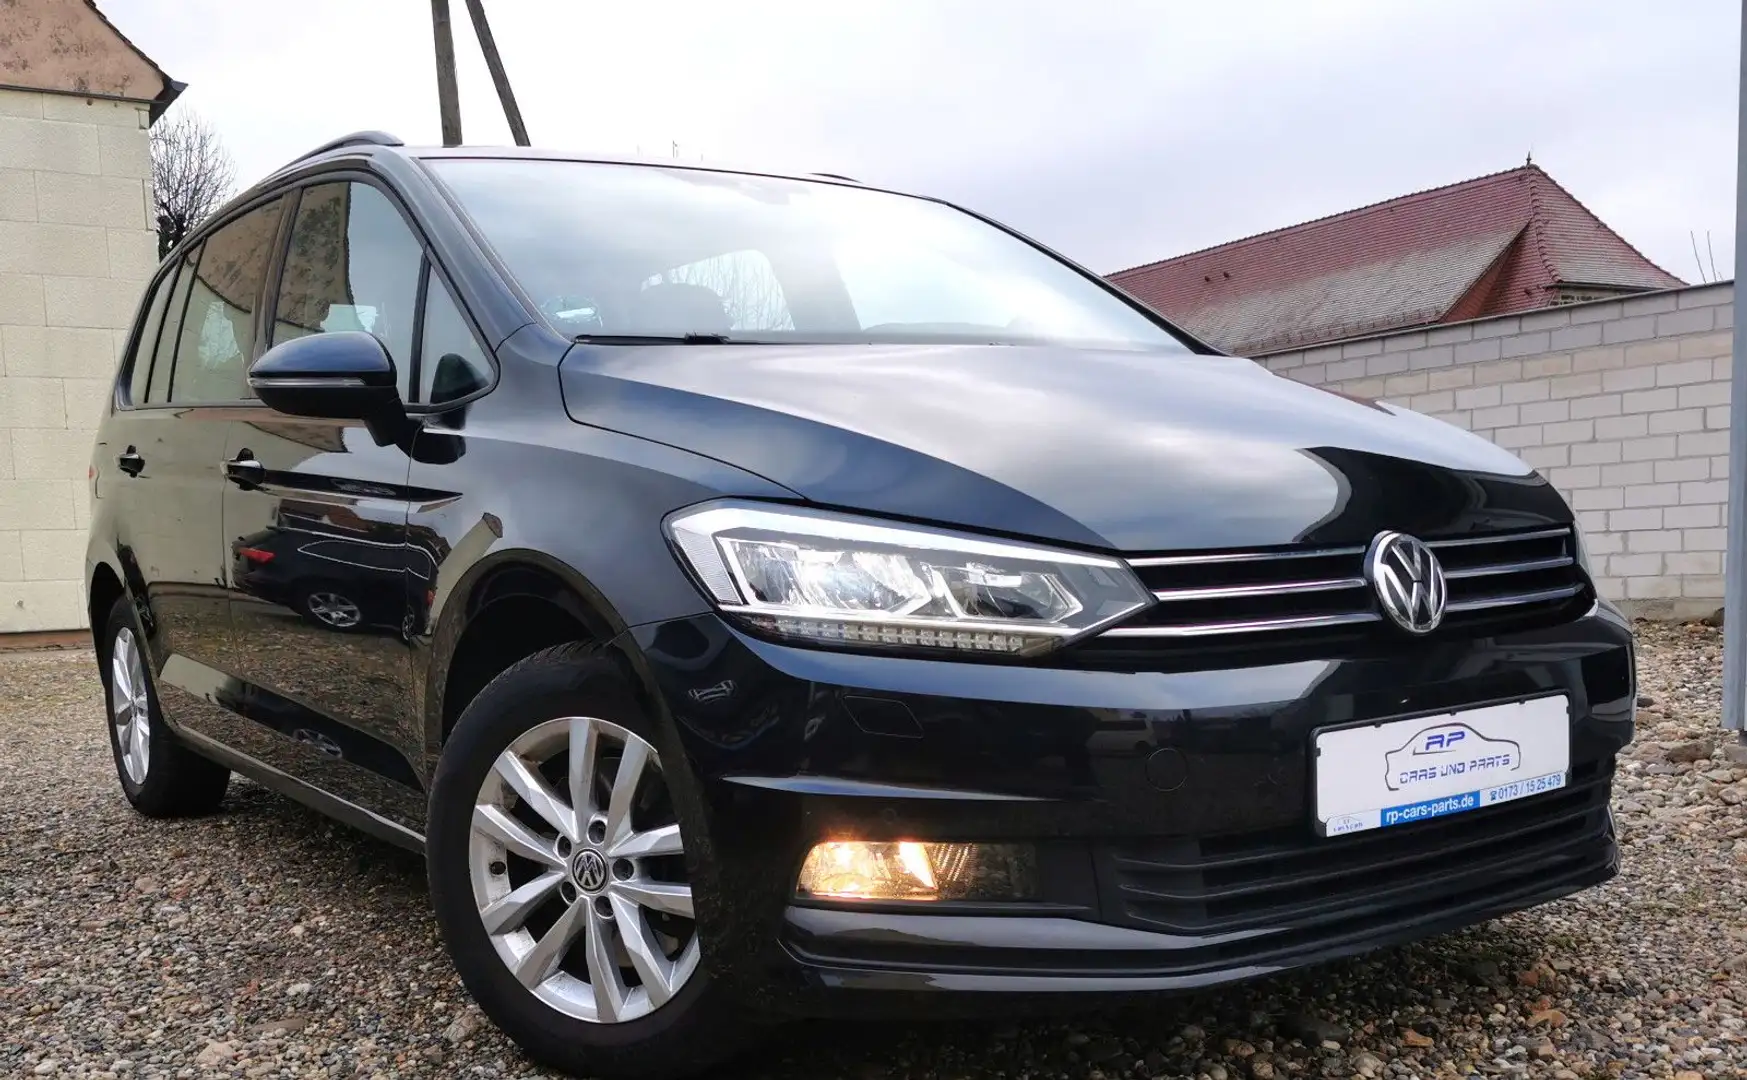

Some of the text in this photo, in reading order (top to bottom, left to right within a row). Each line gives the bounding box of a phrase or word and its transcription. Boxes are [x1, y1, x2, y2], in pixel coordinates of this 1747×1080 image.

[1425, 731, 1466, 751] RP
[1400, 754, 1510, 784] CARS UND PARTS
[1498, 784, 1518, 799] 0173
[1526, 780, 1535, 793] 15
[1536, 777, 1546, 791] 25
[1547, 774, 1562, 787] 479
[1386, 796, 1473, 824] rp-cars-parts.de
